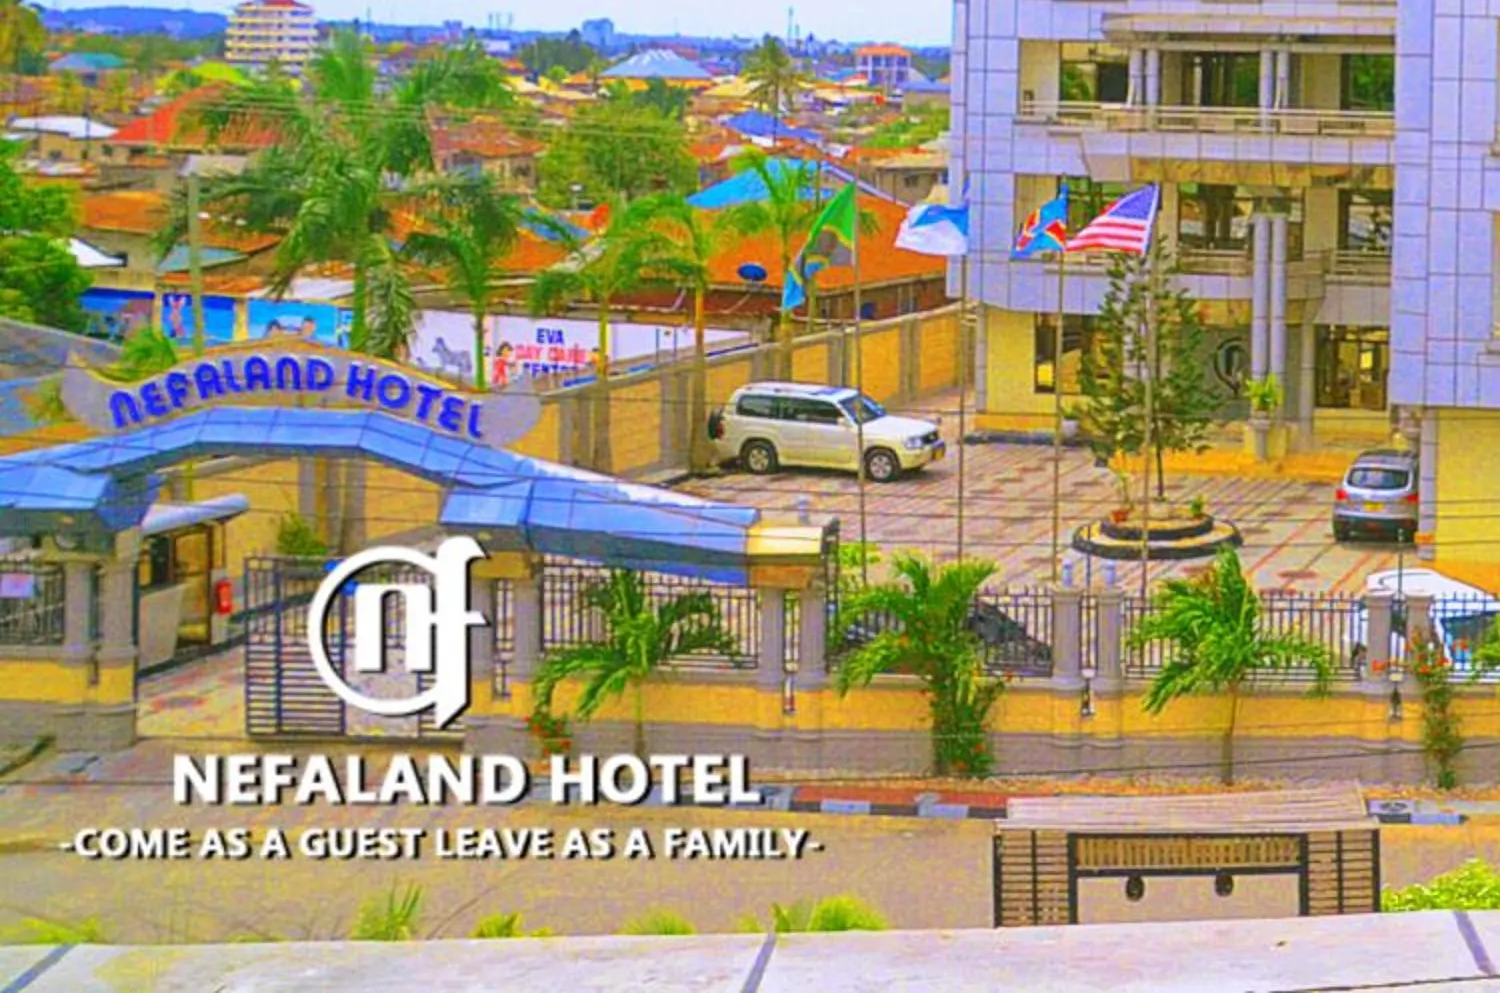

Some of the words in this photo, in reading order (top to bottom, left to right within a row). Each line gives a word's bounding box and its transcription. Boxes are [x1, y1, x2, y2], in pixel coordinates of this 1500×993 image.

[536, 327, 564, 345] EVA
[108, 356, 334, 429] NEFALAND
[346, 362, 483, 439] HOTEL
